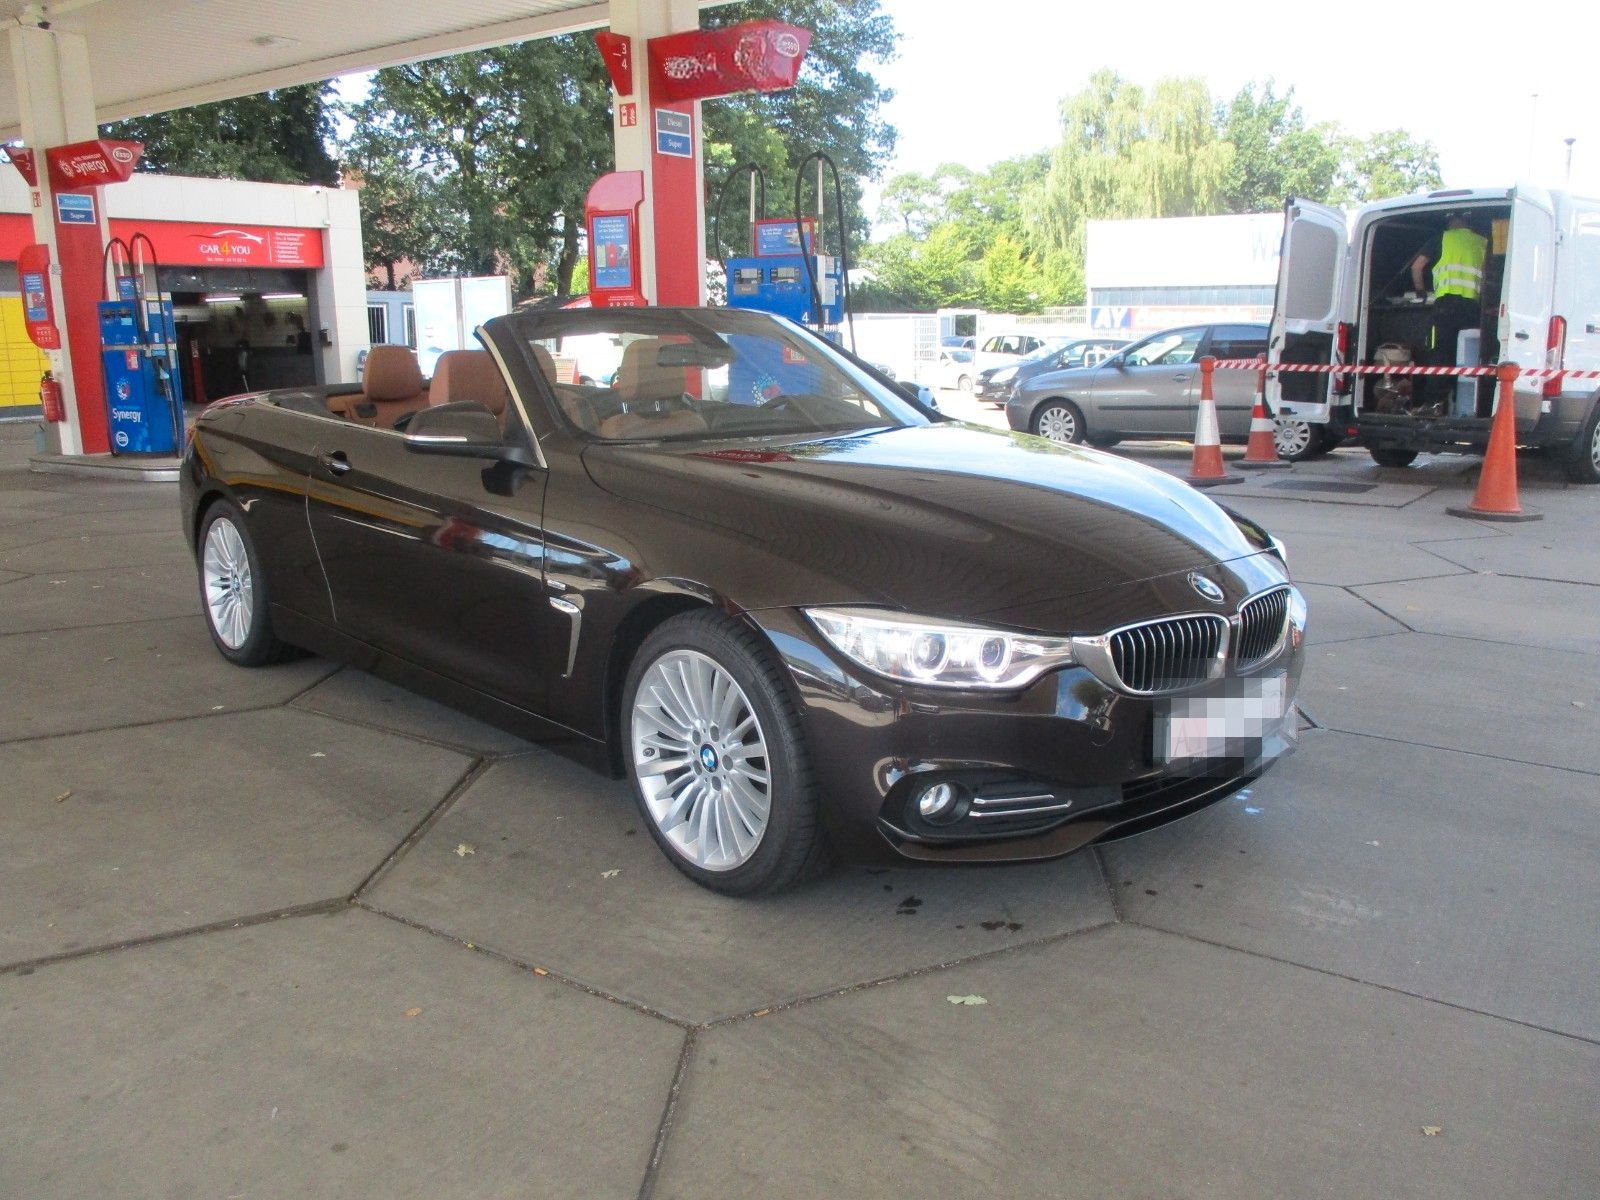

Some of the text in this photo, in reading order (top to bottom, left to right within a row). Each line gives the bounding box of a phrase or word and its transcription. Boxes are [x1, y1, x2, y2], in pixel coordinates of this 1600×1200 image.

[621, 43, 627, 54] 3
[621, 58, 628, 69] 4
[71, 160, 109, 176] Synergy
[200, 240, 251, 255] CAR 4 YOU
[802, 312, 809, 323] 4
[112, 407, 142, 423] Synergy
